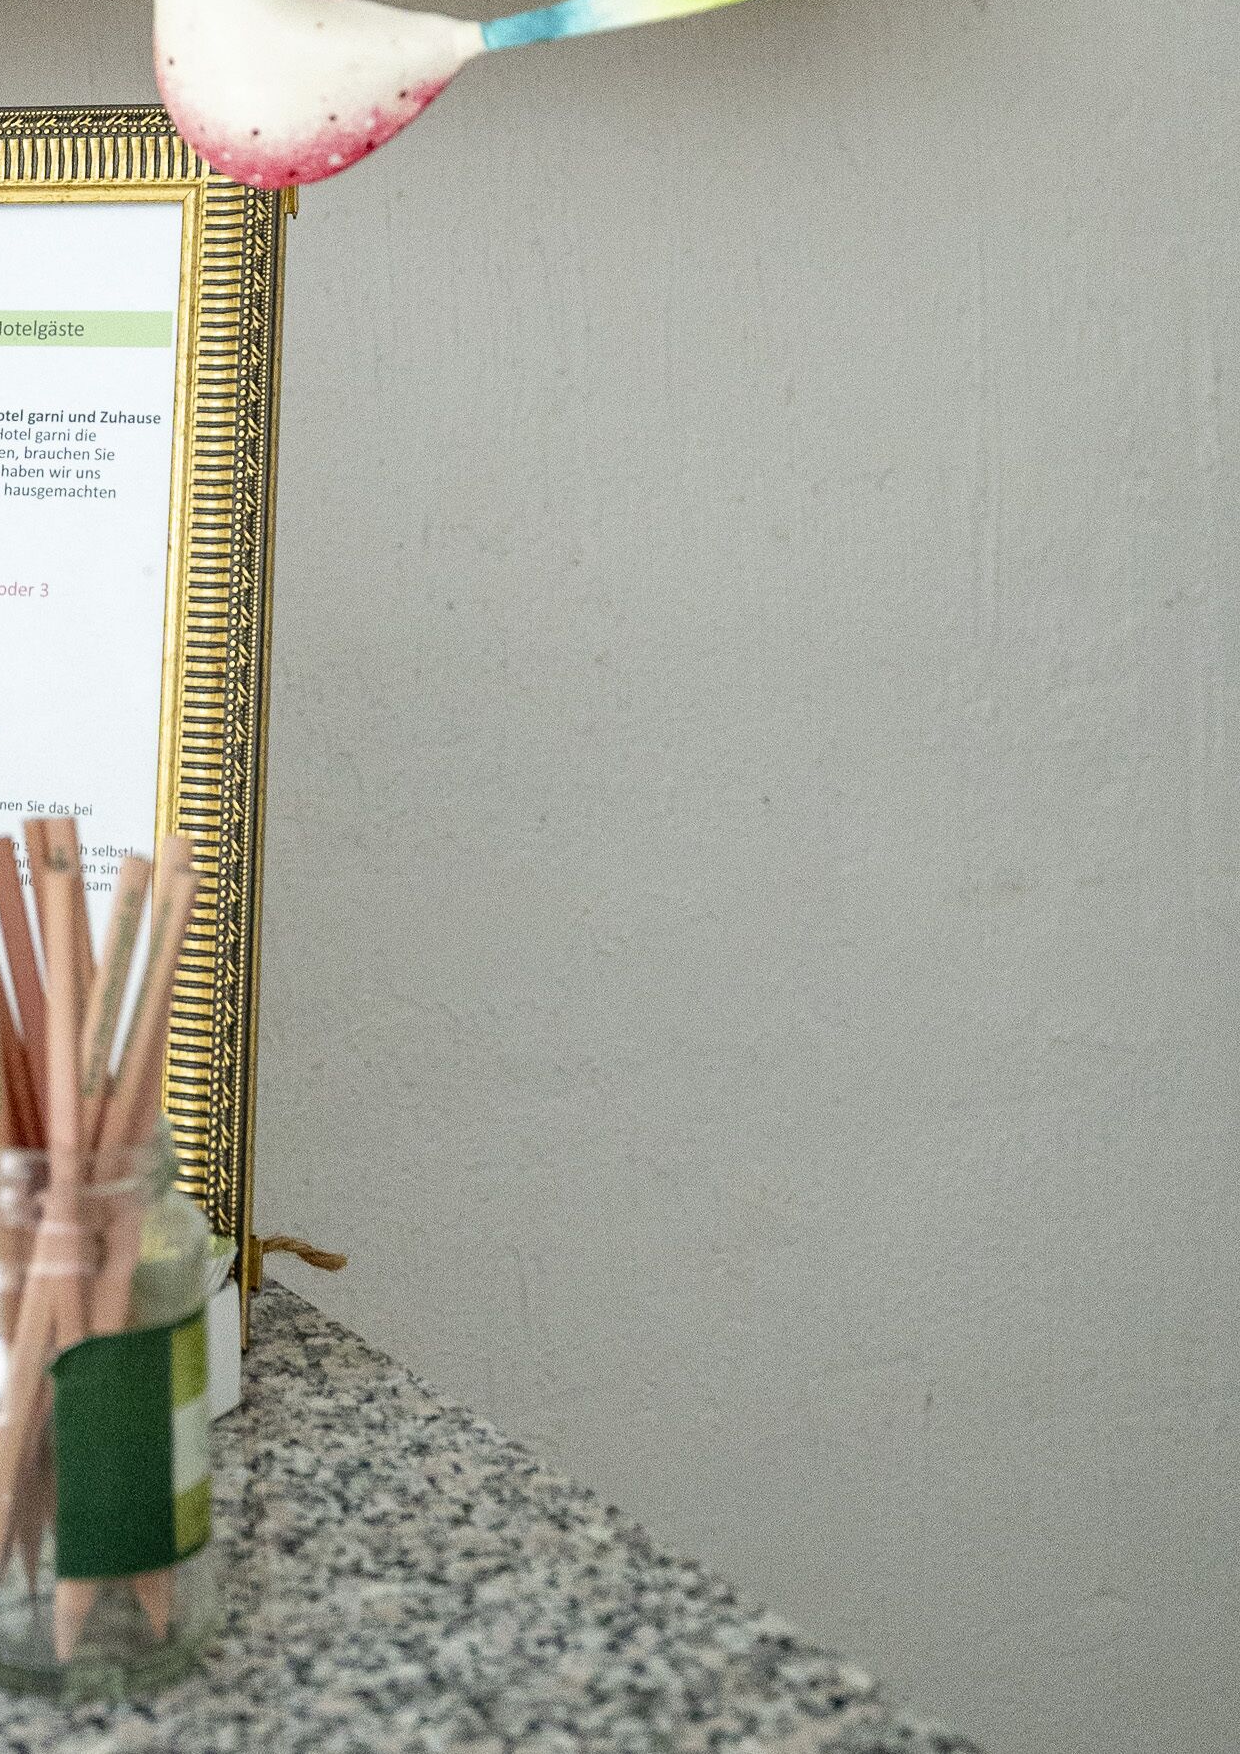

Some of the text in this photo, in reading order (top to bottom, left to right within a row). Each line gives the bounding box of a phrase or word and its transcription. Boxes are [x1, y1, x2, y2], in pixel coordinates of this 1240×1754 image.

[34, 431, 71, 444] garni
[74, 428, 97, 442] die
[23, 446, 91, 460] brauchen
[94, 447, 115, 461] Sie
[0, 464, 45, 478] haben
[48, 466, 72, 479] wir
[75, 469, 101, 480] uns
